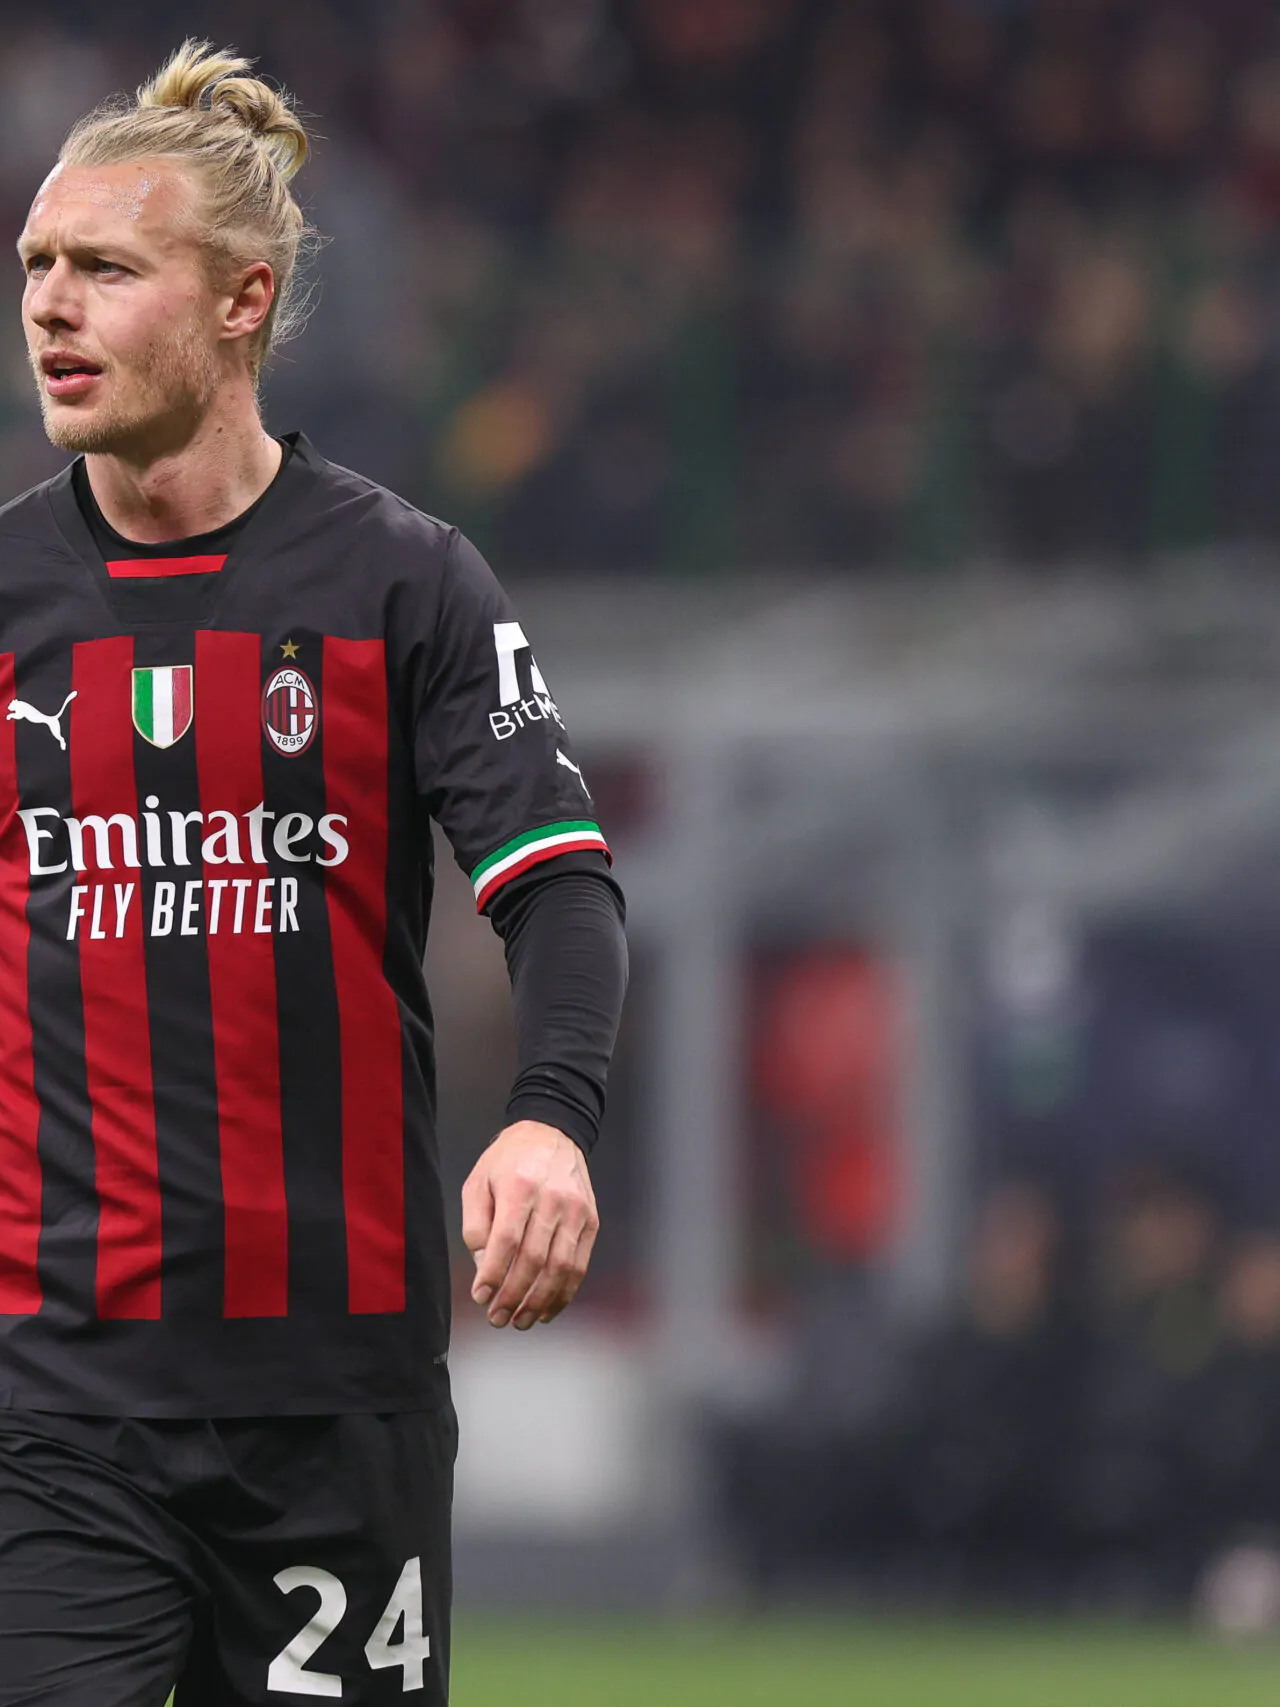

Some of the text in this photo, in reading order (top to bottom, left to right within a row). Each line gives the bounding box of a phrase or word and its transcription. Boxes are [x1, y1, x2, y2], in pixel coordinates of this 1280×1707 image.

[273, 672, 305, 689] ACM
[276, 735, 304, 746] 1899
[15, 795, 349, 876] Emirates
[66, 876, 301, 941] FLY BETTER
[267, 1556, 430, 1698] 24
